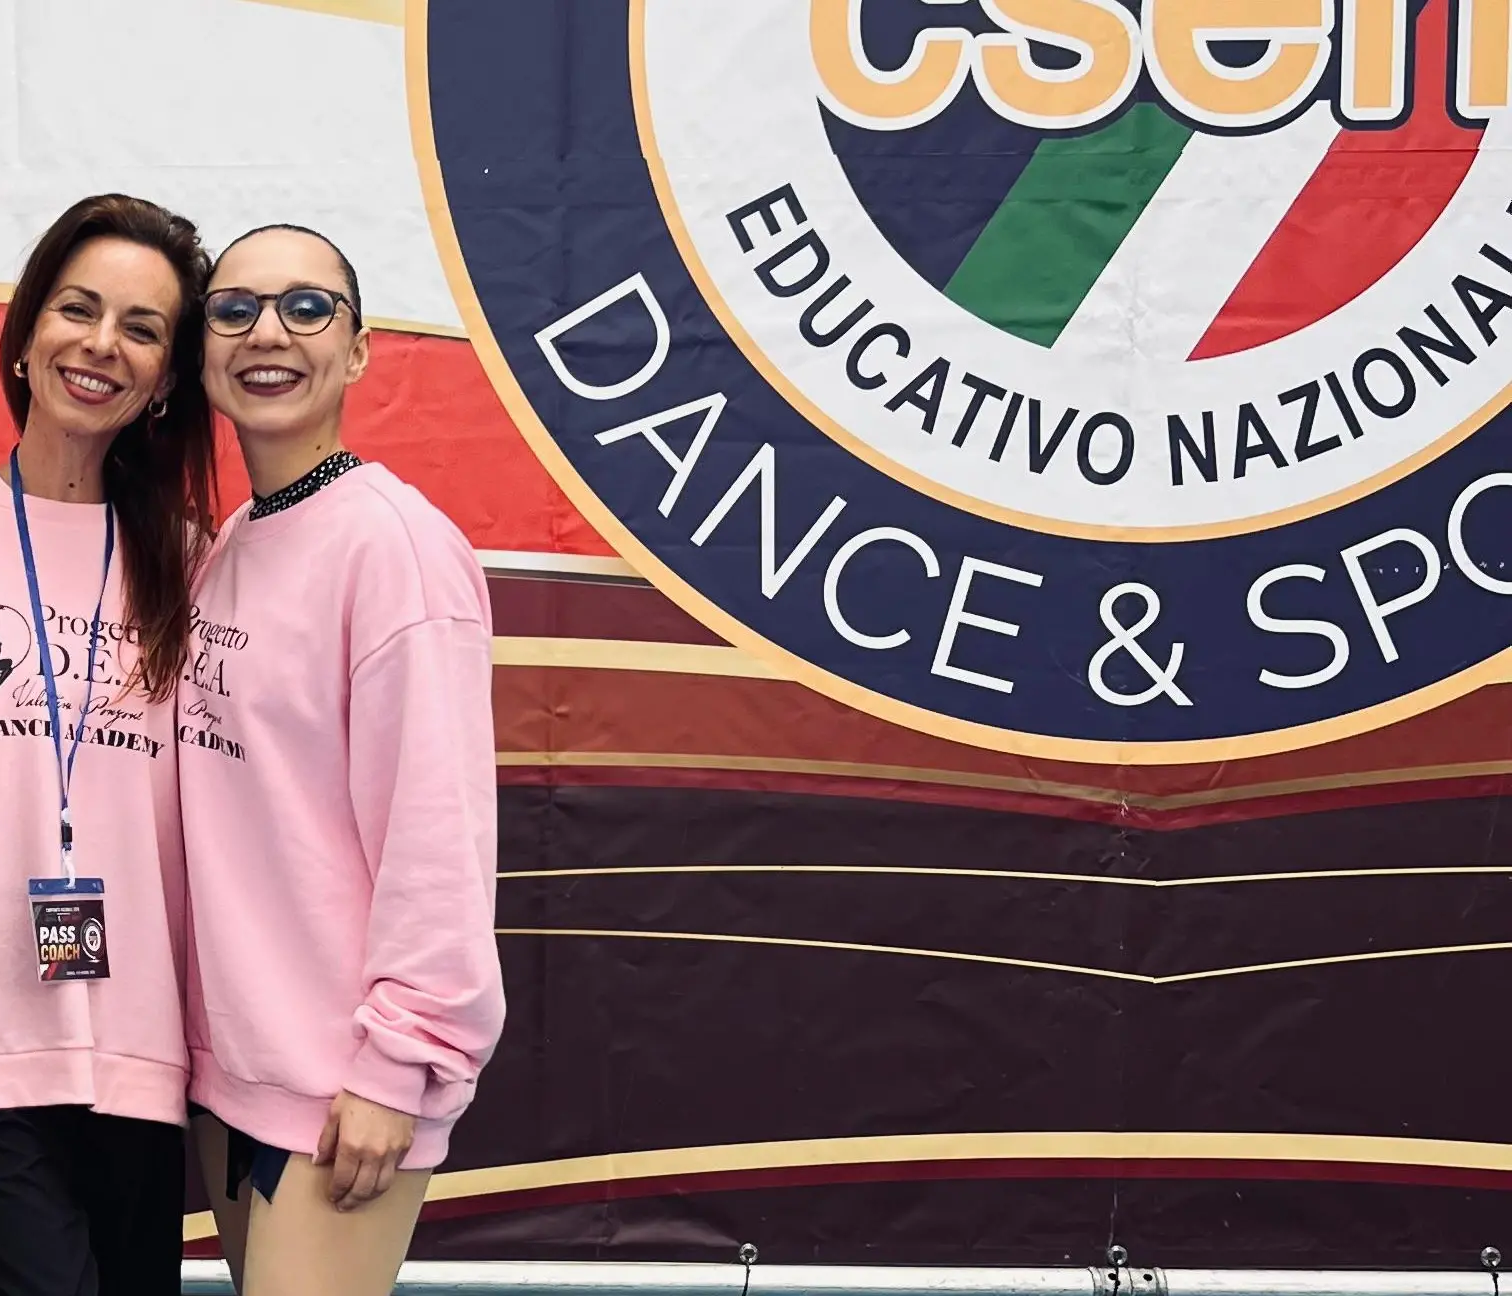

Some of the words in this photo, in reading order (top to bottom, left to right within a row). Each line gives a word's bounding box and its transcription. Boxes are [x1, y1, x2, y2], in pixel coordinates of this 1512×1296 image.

[726, 182, 1134, 486] EDUCATIVO
[1166, 200, 1512, 487] NAZIONA
[533, 271, 1044, 694] DANCE
[1087, 581, 1193, 707] &
[39, 925, 76, 944] PASS
[40, 943, 81, 961] COACH
